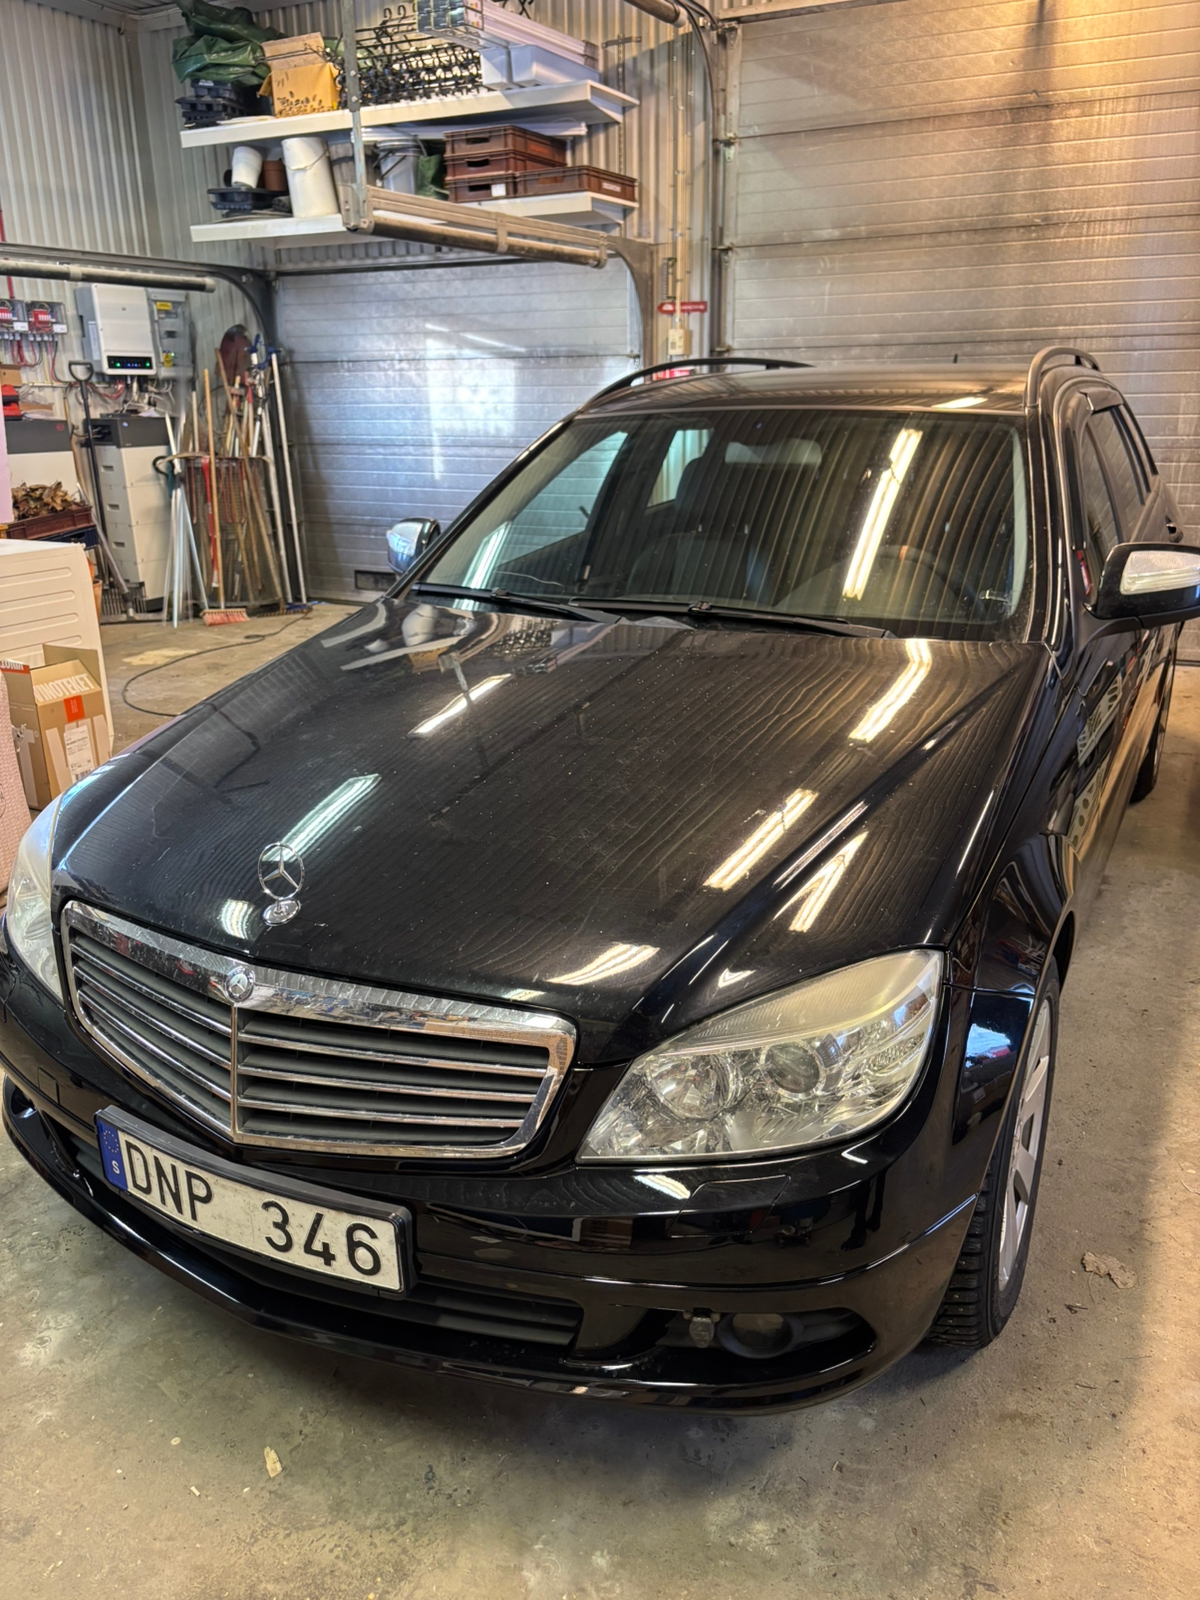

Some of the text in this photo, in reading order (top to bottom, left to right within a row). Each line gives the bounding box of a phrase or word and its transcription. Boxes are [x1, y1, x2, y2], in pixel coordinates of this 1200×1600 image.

[111, 1160, 120, 1174] S
[125, 1140, 382, 1276] DNP 346
